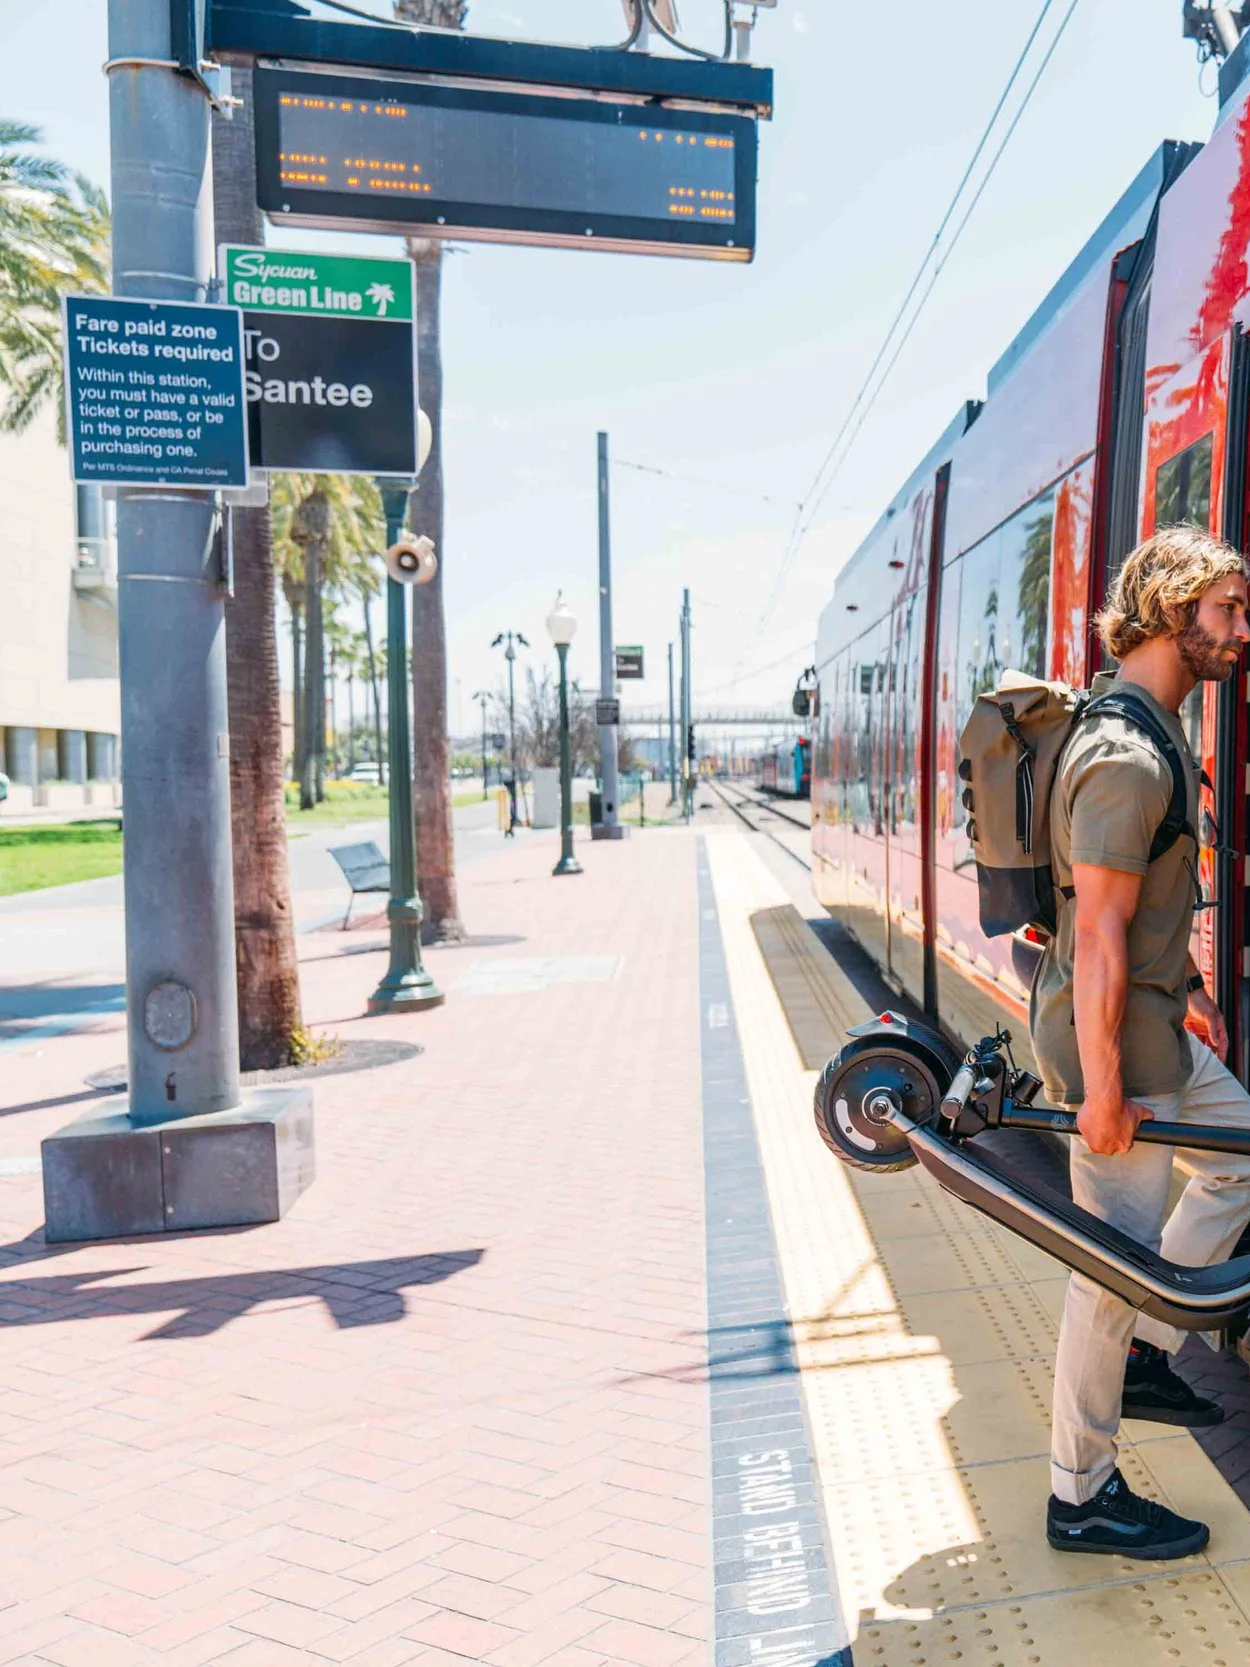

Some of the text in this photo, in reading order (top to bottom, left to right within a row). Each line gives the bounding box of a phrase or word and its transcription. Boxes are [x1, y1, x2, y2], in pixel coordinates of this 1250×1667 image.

[233, 253, 318, 283] Sycuan
[233, 281, 363, 311] Green Line
[75, 314, 217, 340] Fare paid zone
[77, 336, 233, 362] Tickets required
[244, 329, 280, 362] To
[78, 367, 211, 390] Within this station,
[245, 371, 373, 408] Santee
[79, 388, 235, 407] you must have a valid
[79, 404, 224, 424] ticket or pass, or be
[80, 422, 201, 439] in the process of
[81, 440, 198, 458] purchasing one.
[738, 1449, 797, 1516] STAND
[743, 1520, 811, 1615] BEHIND
